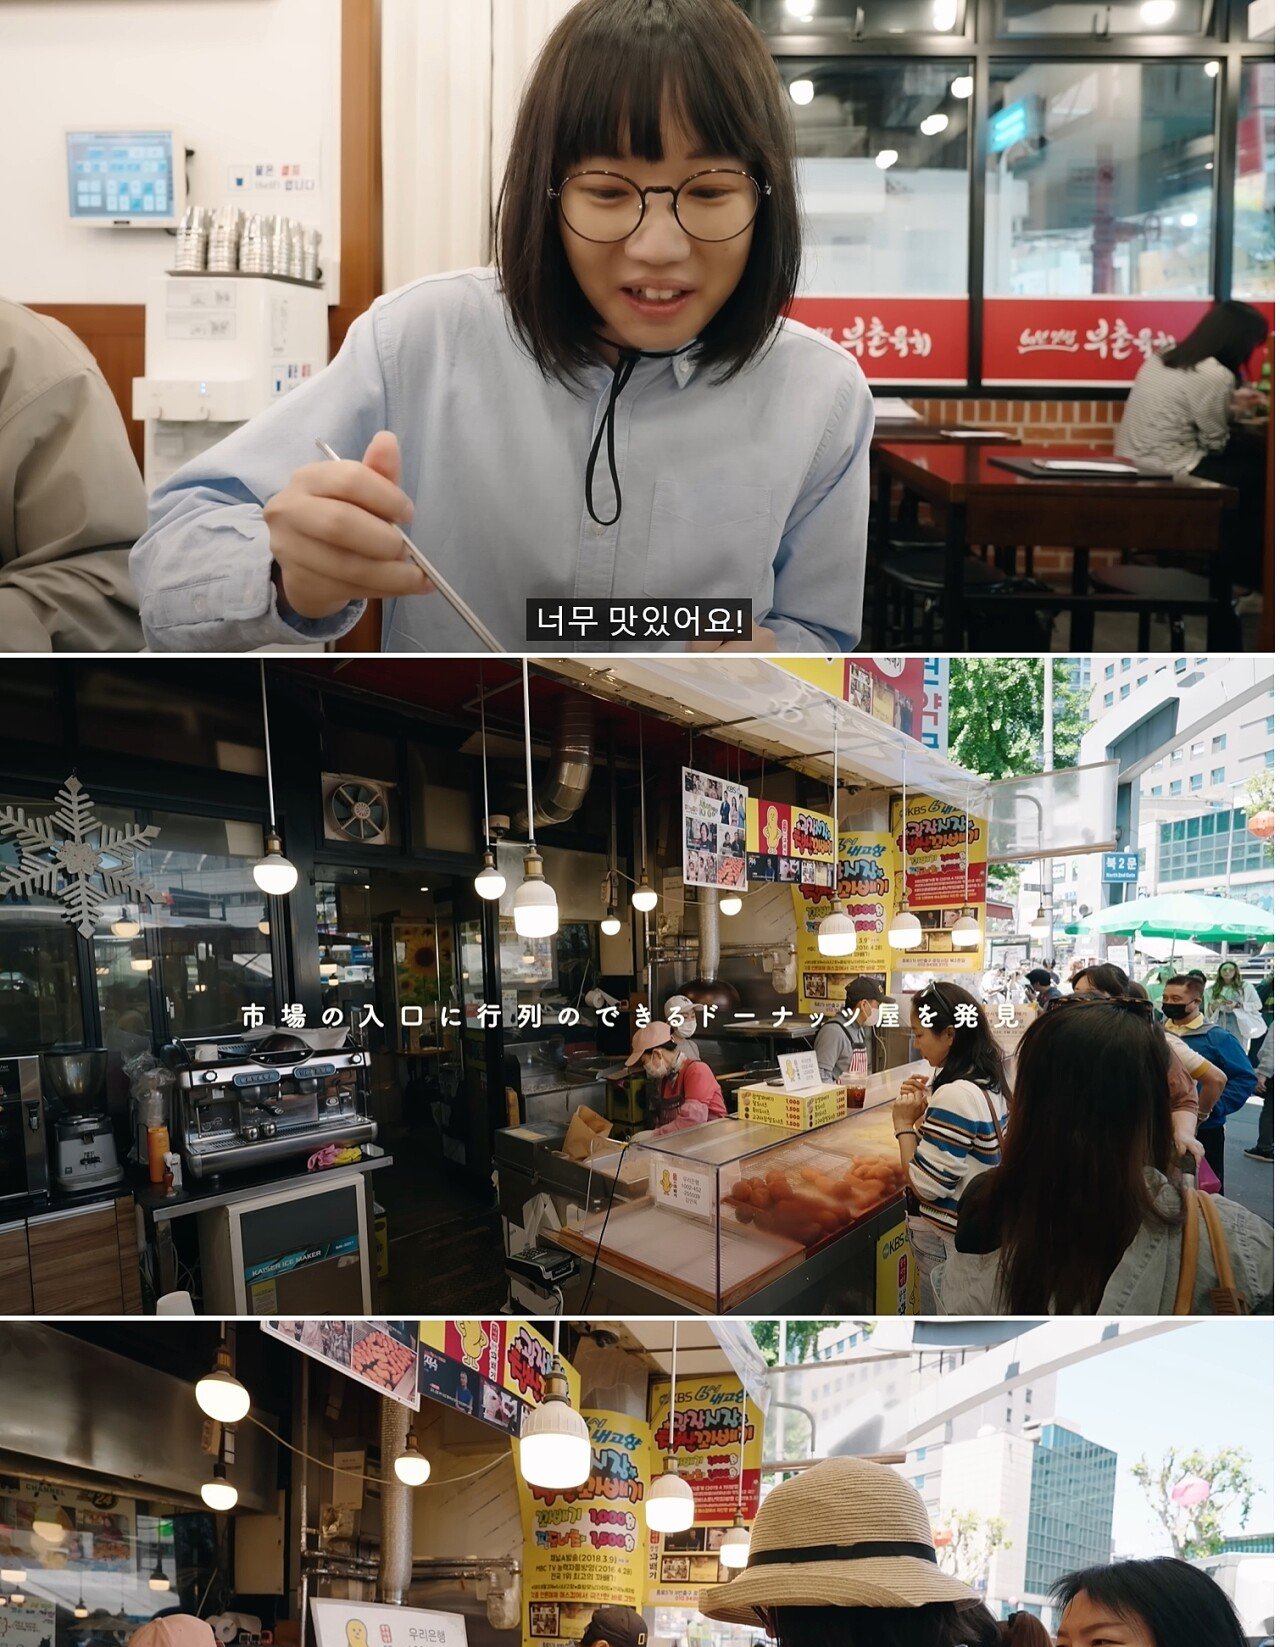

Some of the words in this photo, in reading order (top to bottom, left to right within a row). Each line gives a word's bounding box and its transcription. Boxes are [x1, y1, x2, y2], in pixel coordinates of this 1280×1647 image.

[889, 1233, 904, 1254] KBS
[252, 1262, 281, 1277] KAISER
[282, 1258, 295, 1267] ICE
[296, 1249, 322, 1263] MAKER
[589, 1508, 637, 1531] 1,000원
[589, 1530, 636, 1553] 1,500원
[408, 1627, 447, 1644] 우리은행
